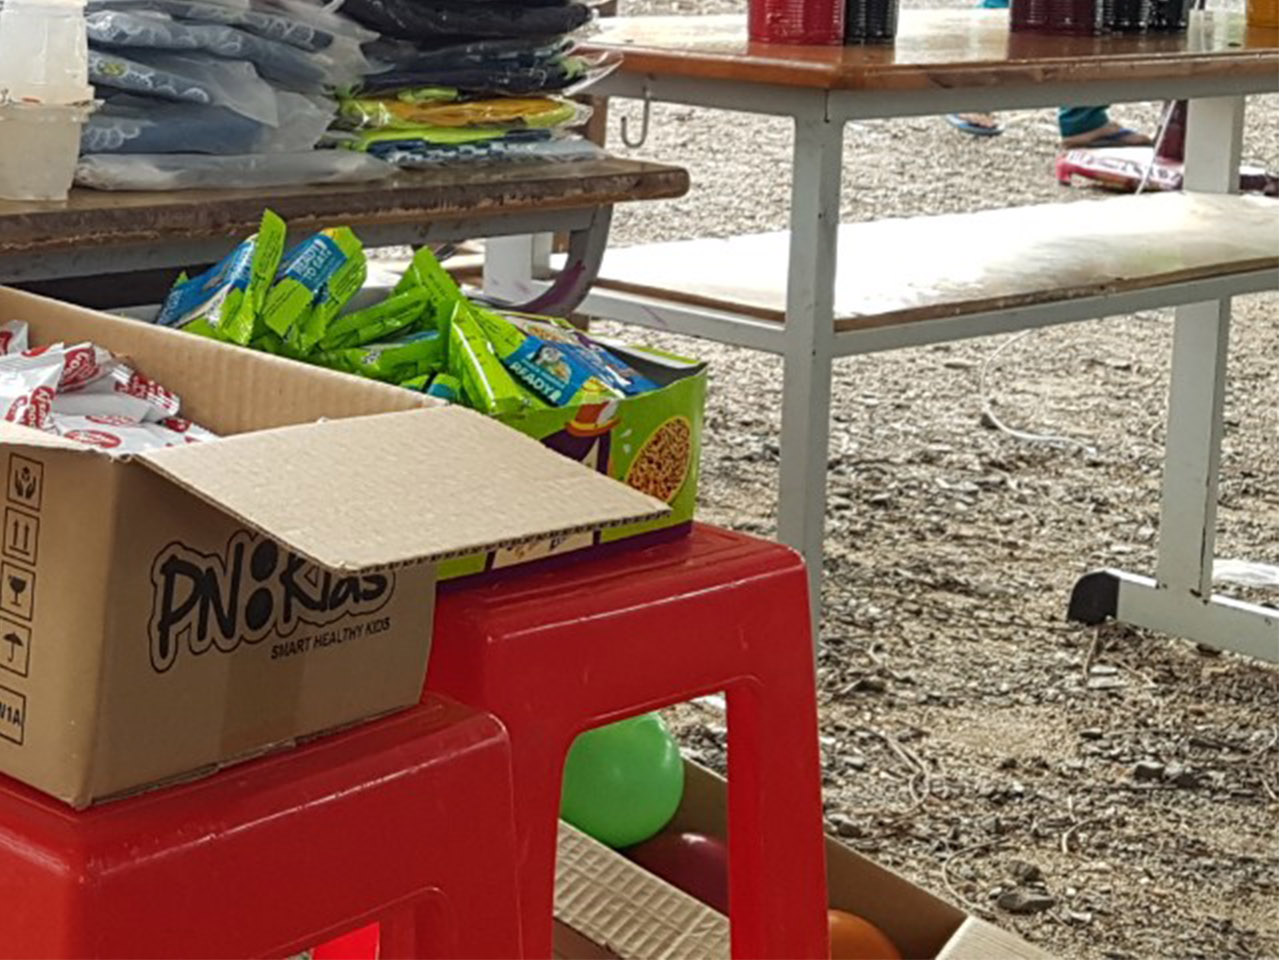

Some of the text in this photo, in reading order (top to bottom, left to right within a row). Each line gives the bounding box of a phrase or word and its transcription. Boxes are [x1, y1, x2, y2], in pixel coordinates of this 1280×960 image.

[271, 617, 391, 659] SMART HEALTHY KIDS
